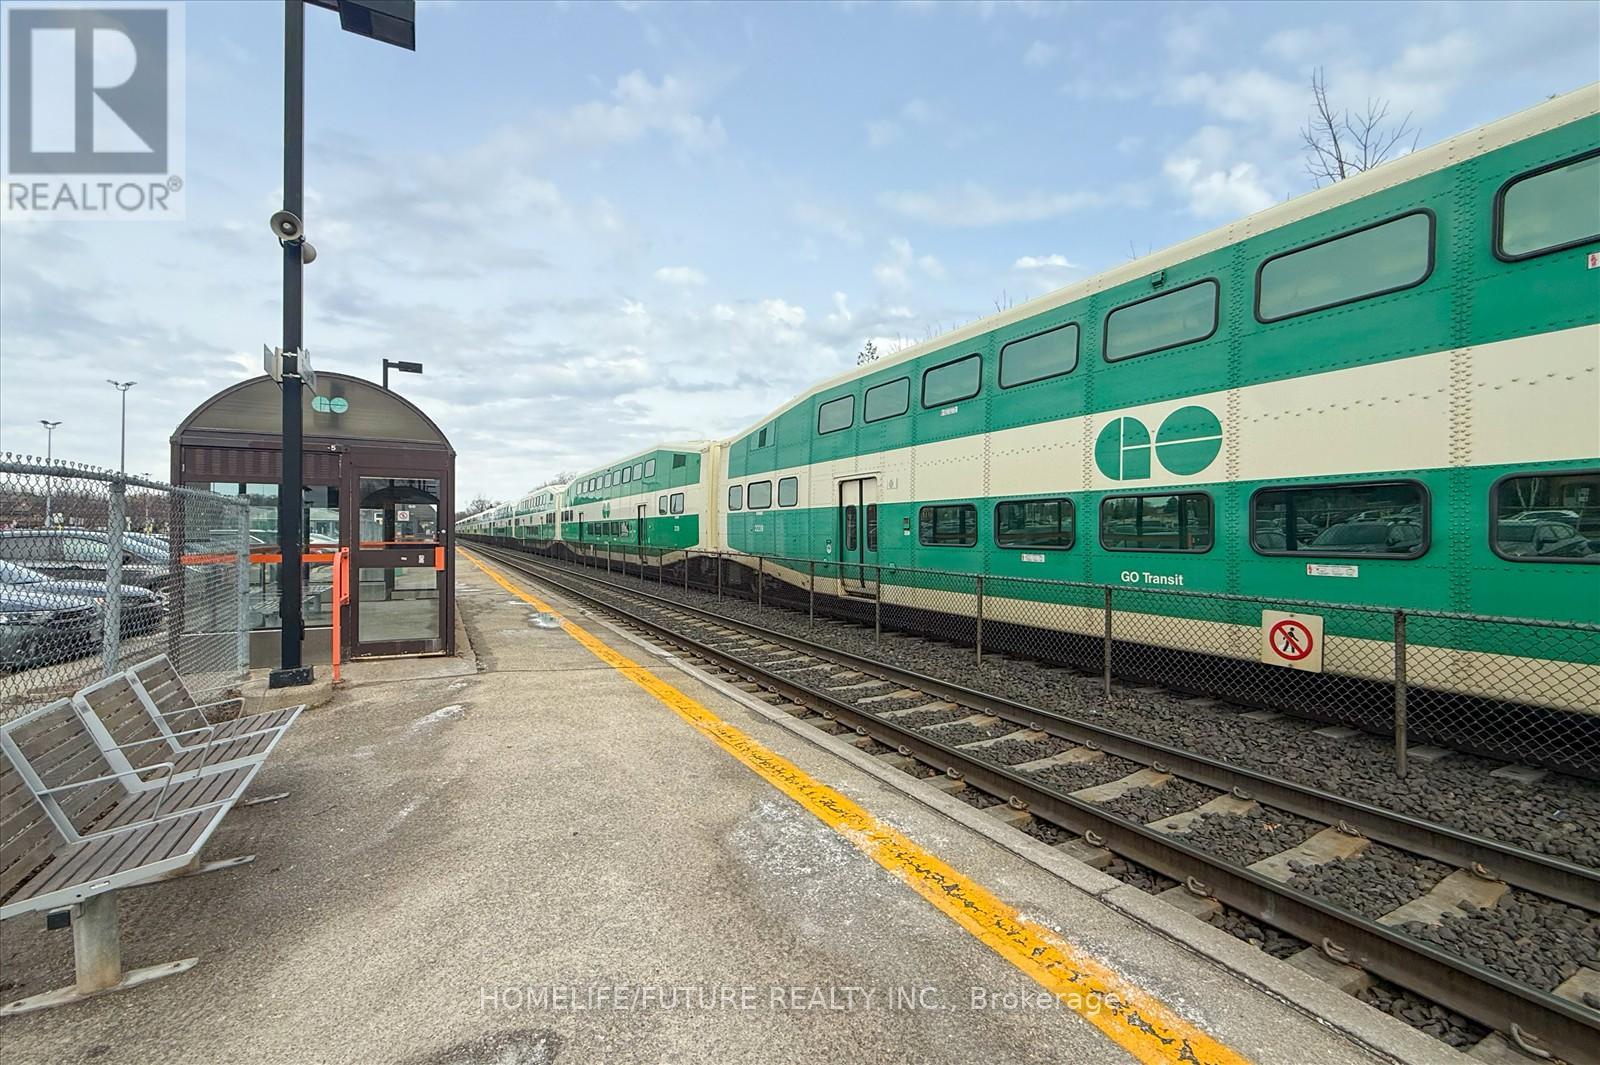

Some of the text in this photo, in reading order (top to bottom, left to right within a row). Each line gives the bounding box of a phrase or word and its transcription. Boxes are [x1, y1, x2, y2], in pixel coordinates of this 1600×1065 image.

[1094, 405, 1223, 481] GO
[1120, 571, 1184, 586] GO Transit
